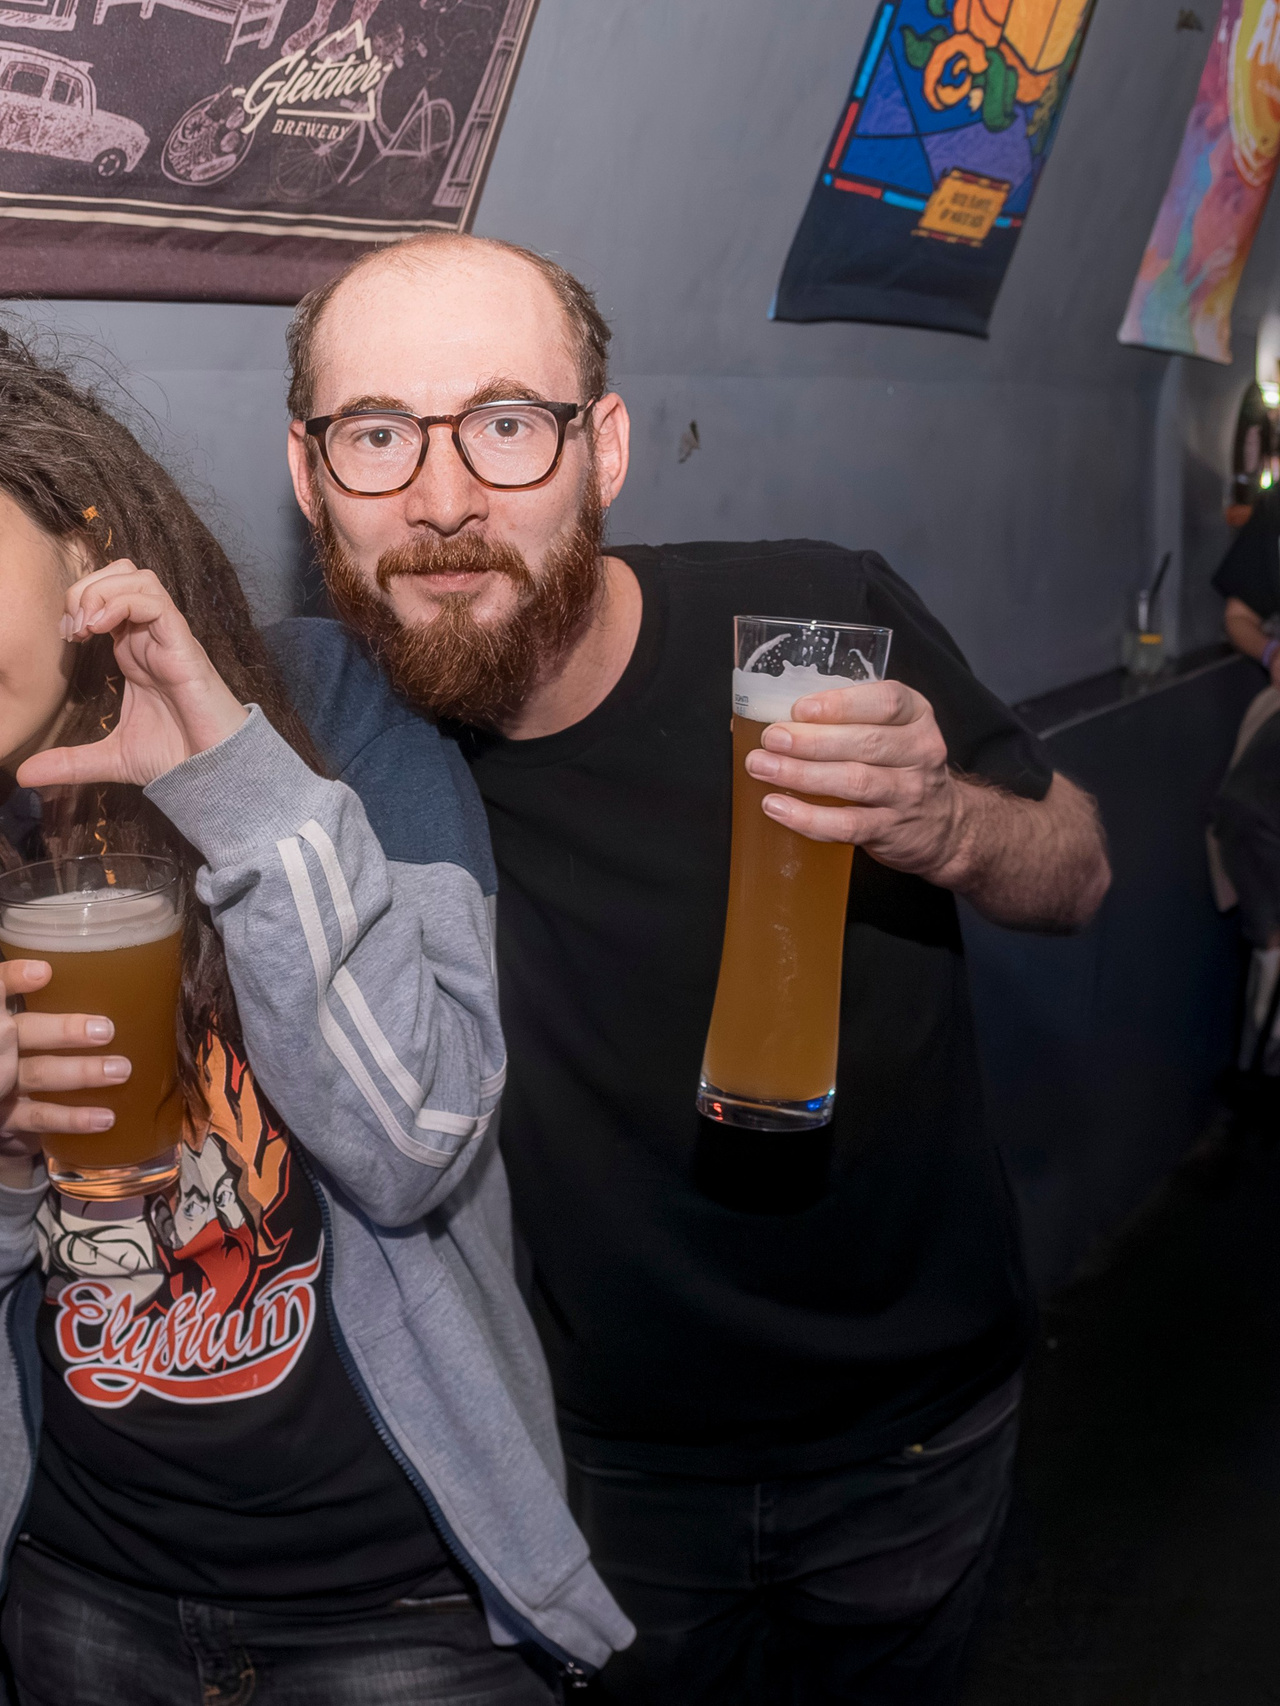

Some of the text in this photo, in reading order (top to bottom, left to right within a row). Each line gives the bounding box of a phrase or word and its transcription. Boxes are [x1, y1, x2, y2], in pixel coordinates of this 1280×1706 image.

[232, 50, 393, 134] Gletcher
[272, 119, 349, 140] BREWERY
[55, 1258, 322, 1408] Elysium
